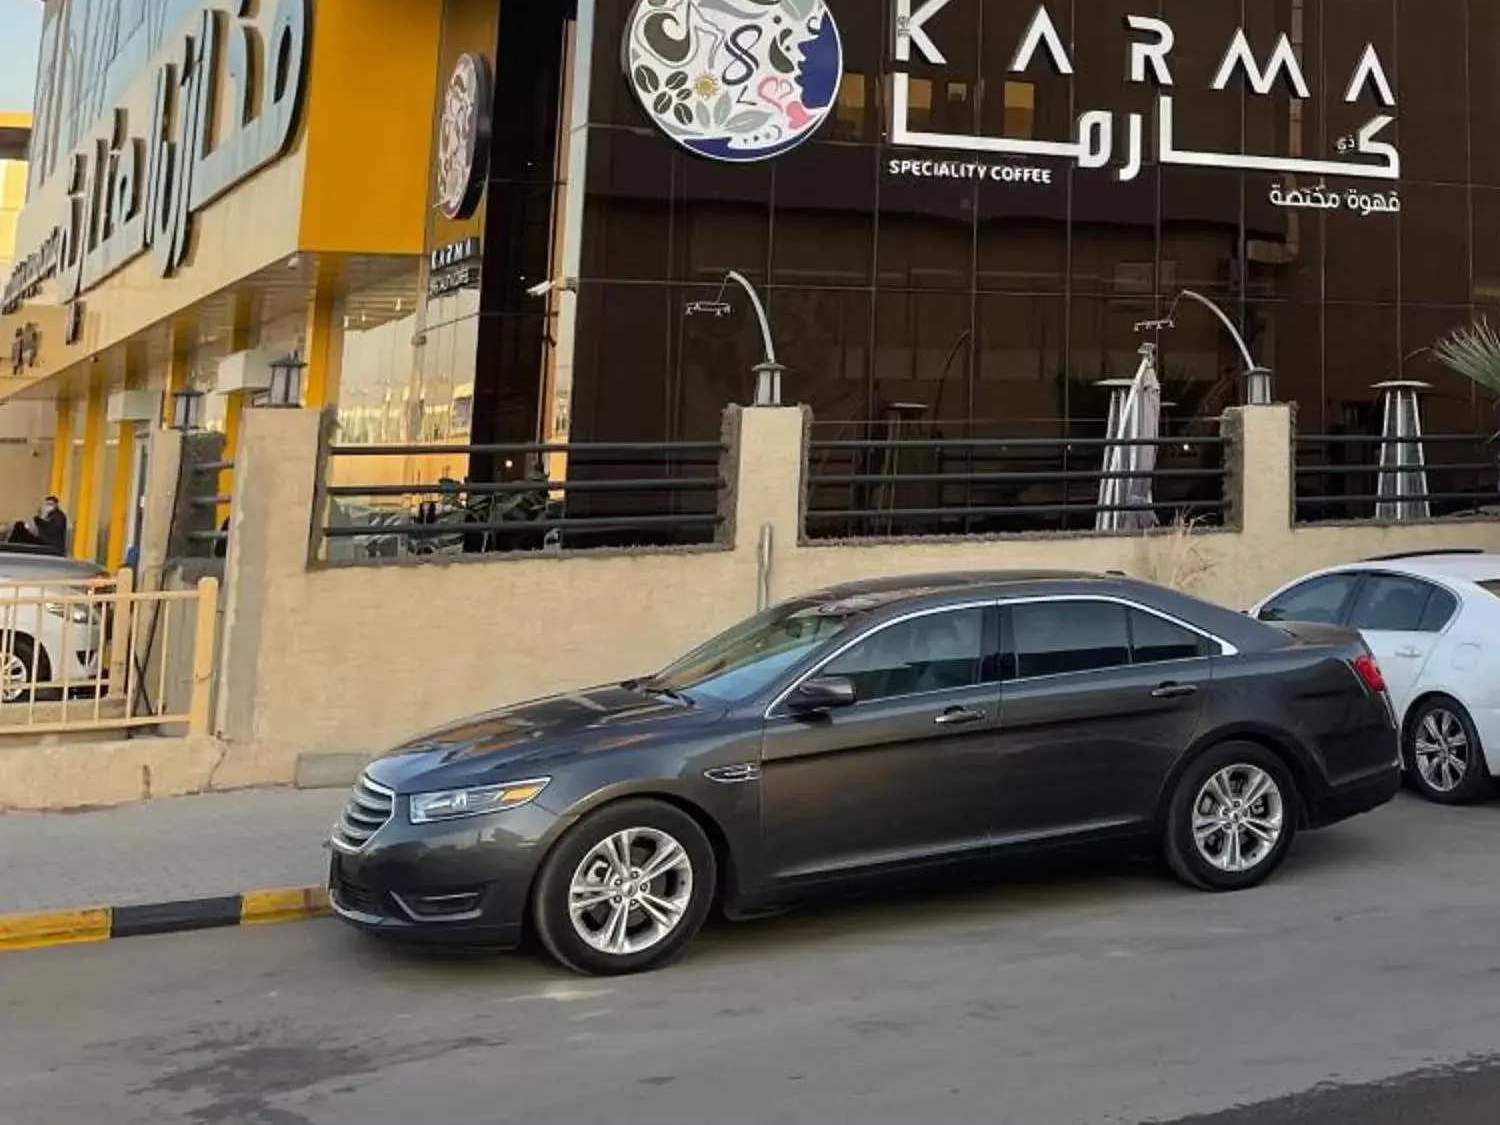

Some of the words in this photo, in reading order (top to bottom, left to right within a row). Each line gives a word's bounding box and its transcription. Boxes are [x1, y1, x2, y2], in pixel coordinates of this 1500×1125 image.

[889, 159, 988, 180] SPECIALITY
[990, 165, 1052, 184] COFFEE
[1269, 183, 1340, 209] مختصة
[1346, 188, 1400, 215] قهوة
